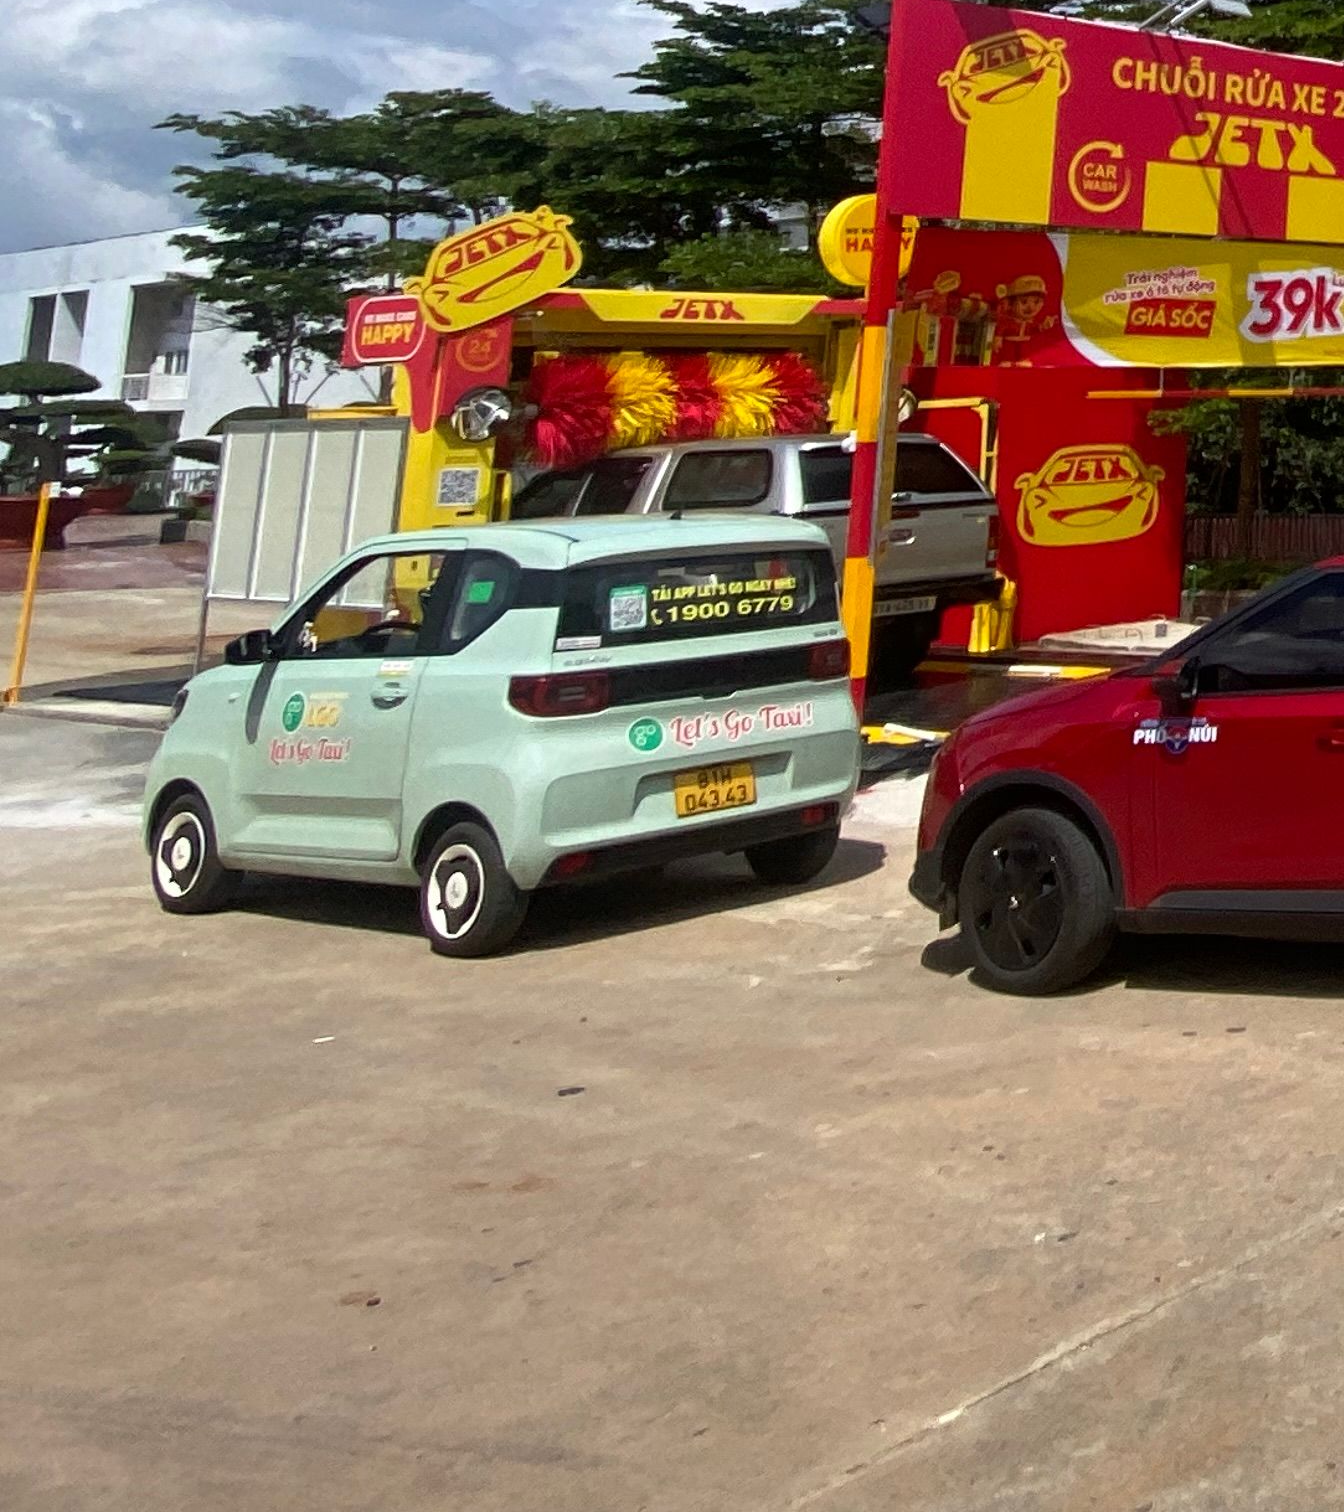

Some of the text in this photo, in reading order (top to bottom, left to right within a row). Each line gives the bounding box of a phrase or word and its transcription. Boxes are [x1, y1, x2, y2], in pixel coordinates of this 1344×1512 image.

[1112, 55, 1216, 101] CHUỖI
[1225, 68, 1287, 110] RỬA
[1292, 83, 1327, 117] XE
[1169, 112, 1337, 176] JETX
[1083, 162, 1118, 180] CAR
[445, 225, 534, 274] JETX
[659, 298, 745, 321] JETX
[1131, 301, 1212, 329] GIÁ SỐC
[1249, 275, 1343, 336] 39k
[361, 321, 415, 345] HAPPY
[1051, 456, 1132, 483] JETX
[666, 595, 794, 622] 1900 6779
[670, 712, 720, 747] Let's
[724, 709, 753, 740] Go
[1188, 723, 1218, 743] NÚI
